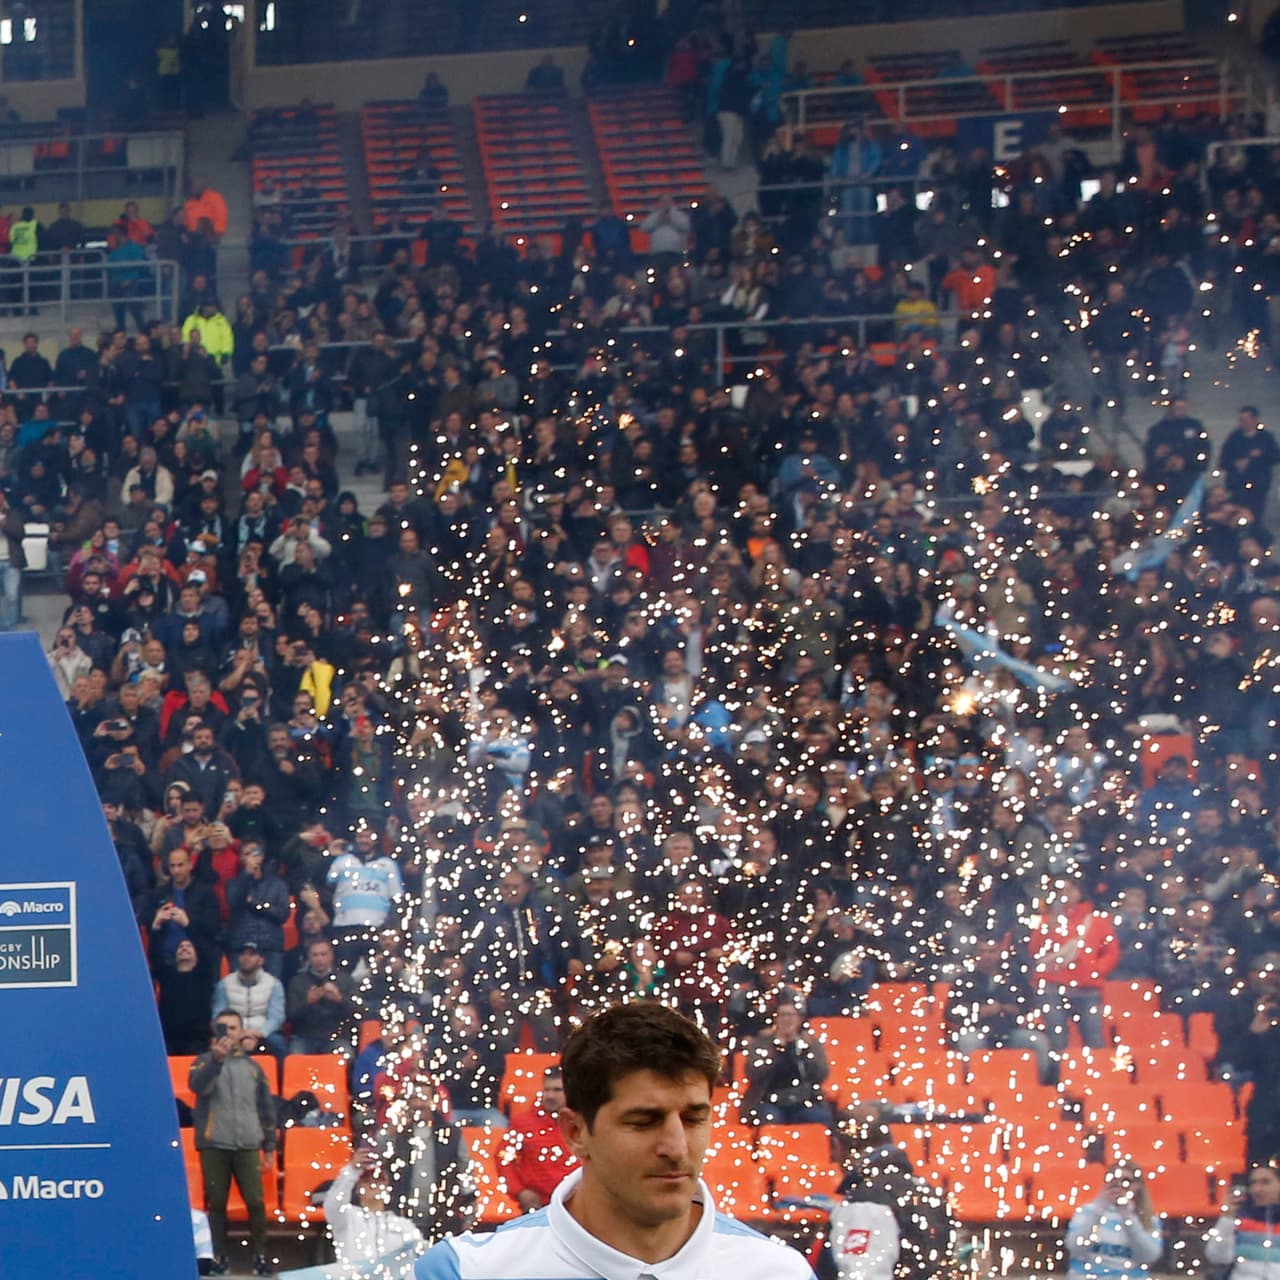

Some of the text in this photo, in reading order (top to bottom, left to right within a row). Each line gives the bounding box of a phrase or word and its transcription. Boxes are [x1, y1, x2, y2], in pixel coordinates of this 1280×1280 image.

[993, 121, 1024, 160] E
[23, 901, 64, 914] Macro
[12, 1175, 105, 1200] Macro
